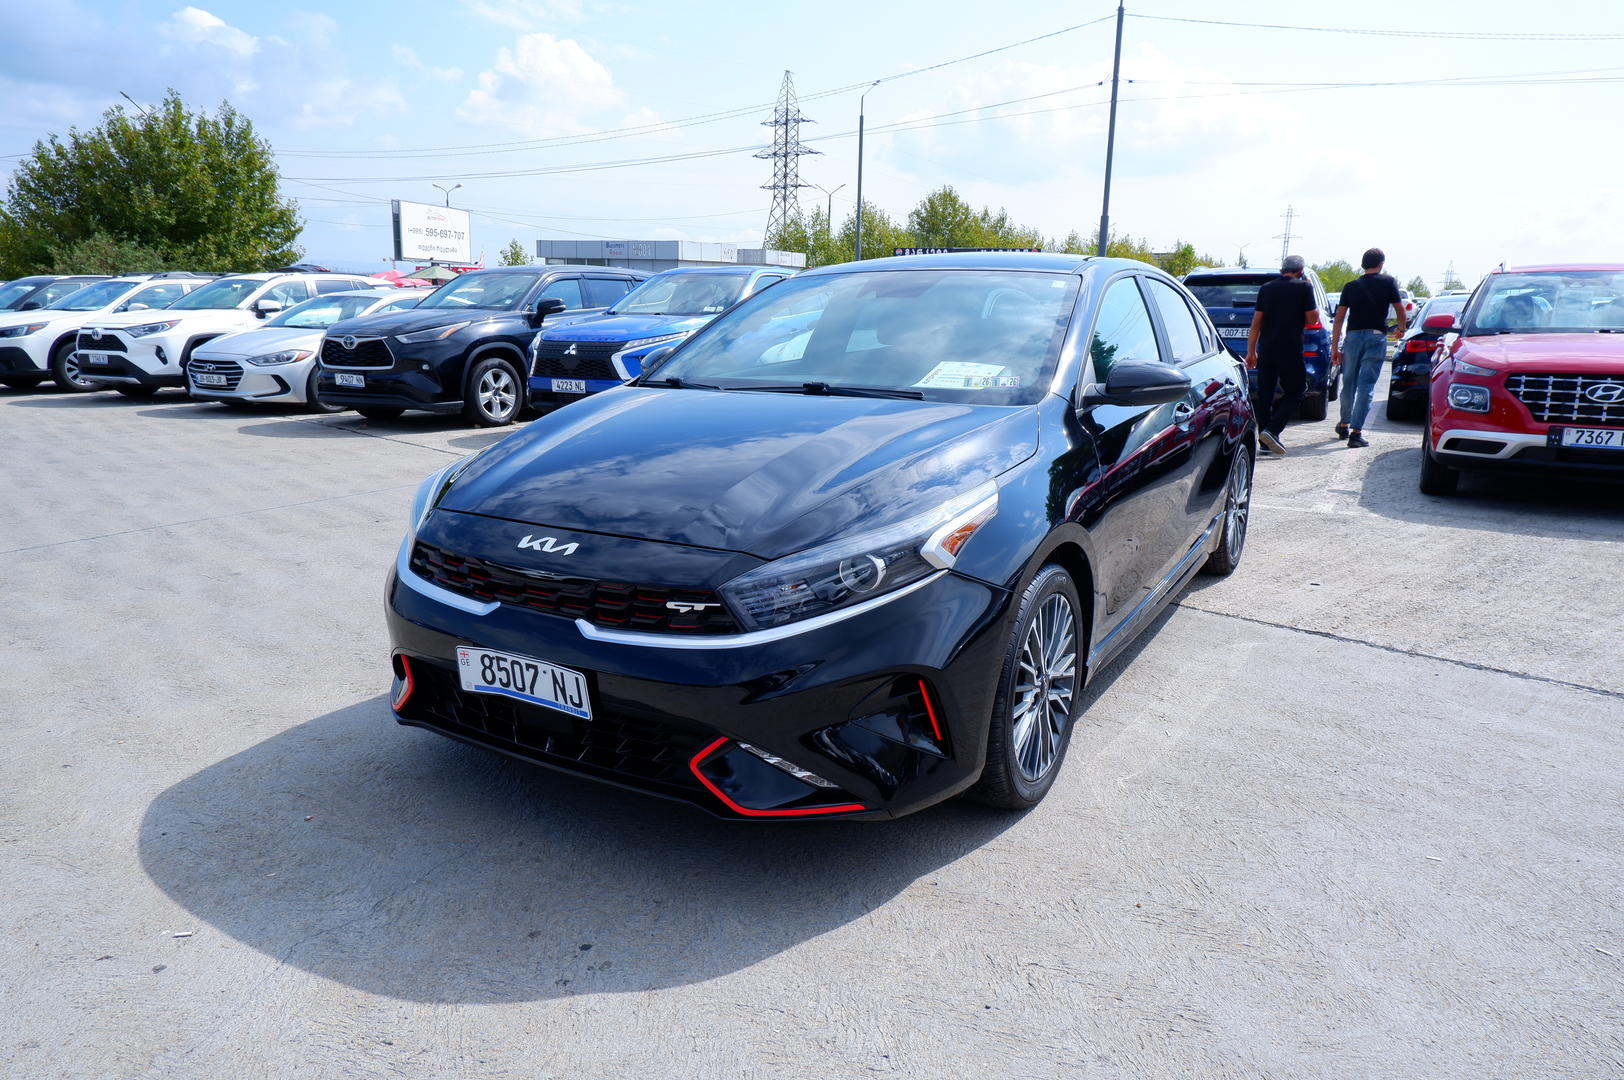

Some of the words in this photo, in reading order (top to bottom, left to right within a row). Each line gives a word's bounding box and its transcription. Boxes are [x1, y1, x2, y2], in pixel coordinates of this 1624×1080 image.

[425, 227, 465, 240] 595-697-707
[556, 380, 573, 391] 4223
[1575, 429, 1615, 445] 7367
[517, 534, 580, 556] KIA
[666, 601, 721, 613] GT
[460, 658, 470, 666] GE
[480, 653, 539, 695] 8507
[551, 668, 584, 709] NJ
